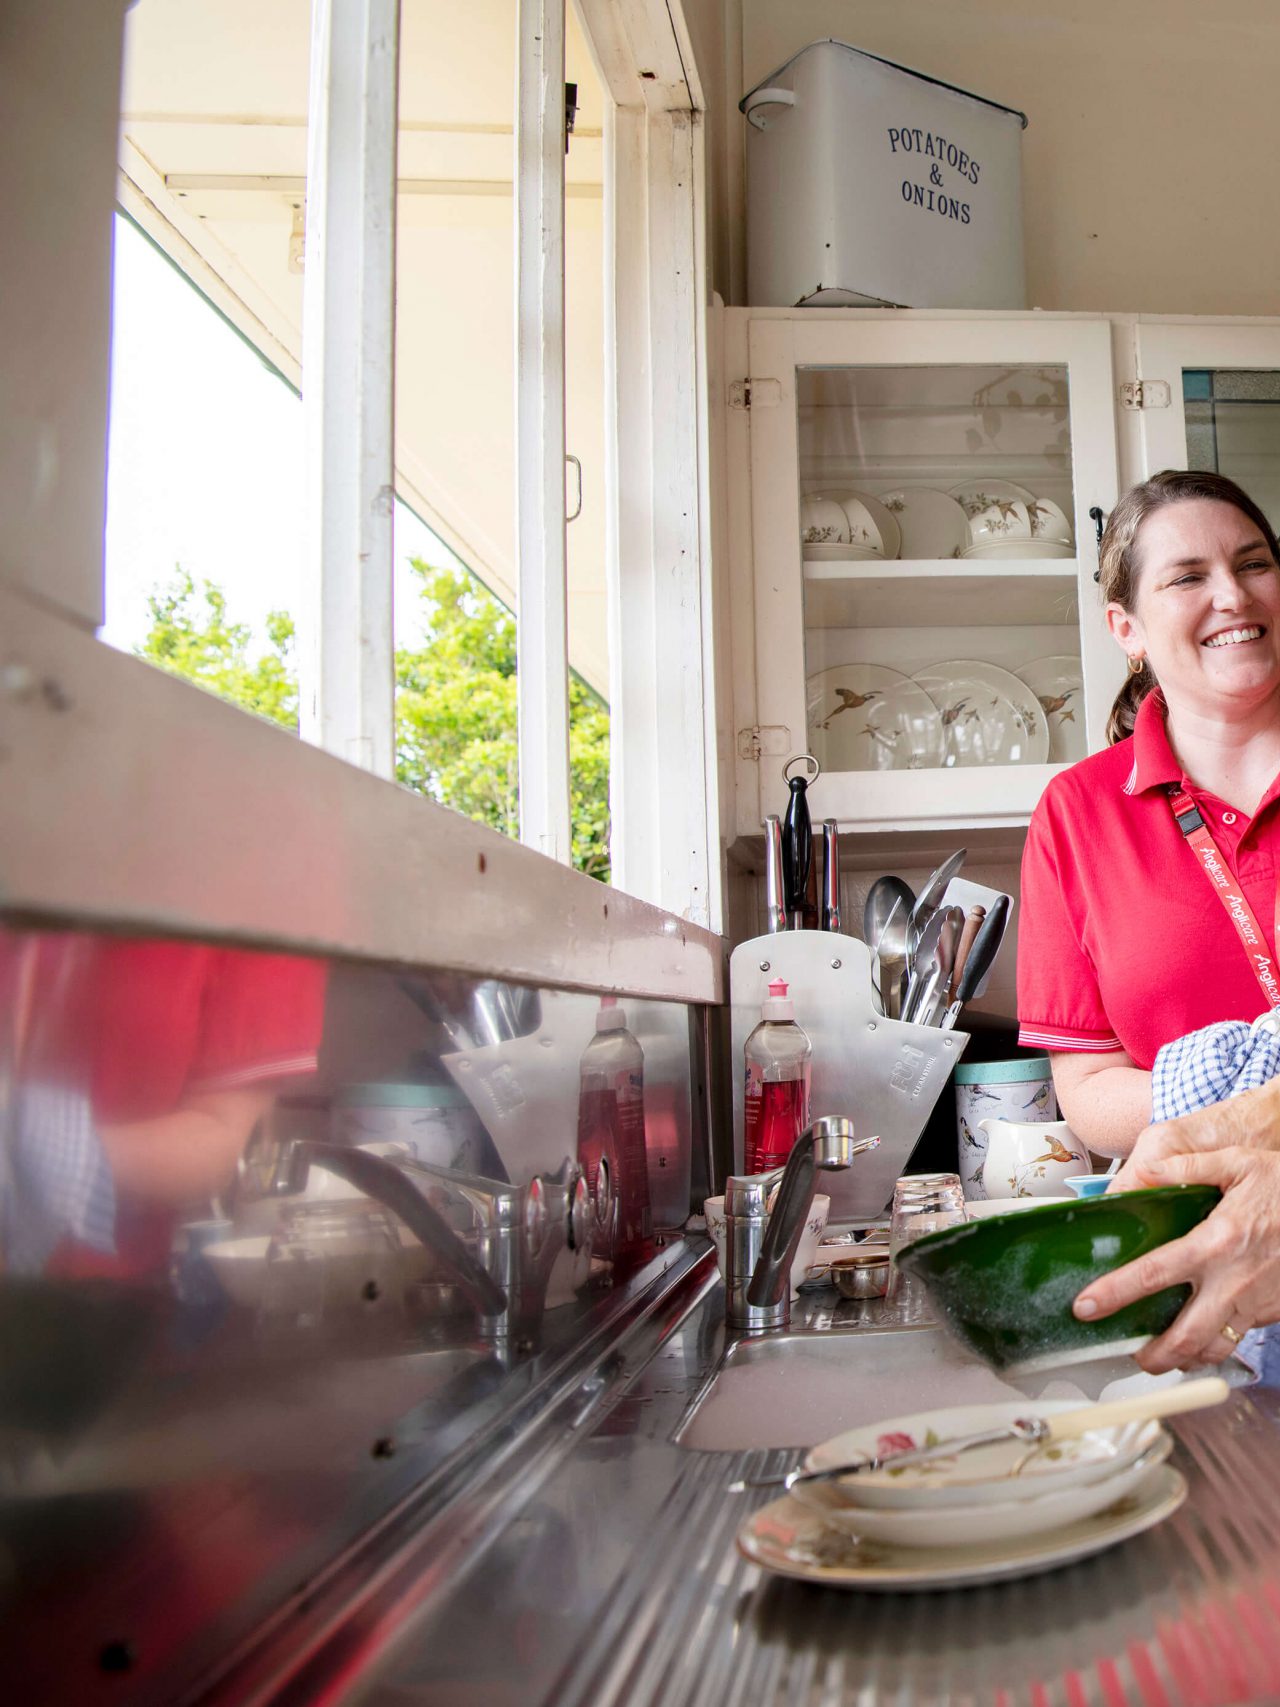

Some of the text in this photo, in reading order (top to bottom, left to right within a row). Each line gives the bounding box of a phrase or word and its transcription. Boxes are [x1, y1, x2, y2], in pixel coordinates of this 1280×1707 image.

[888, 128, 981, 185] POTATOES
[929, 163, 944, 188] &
[902, 180, 971, 225] ONIONS
[1200, 847, 1230, 889] Anglicare
[1226, 894, 1260, 946] Anglicare
